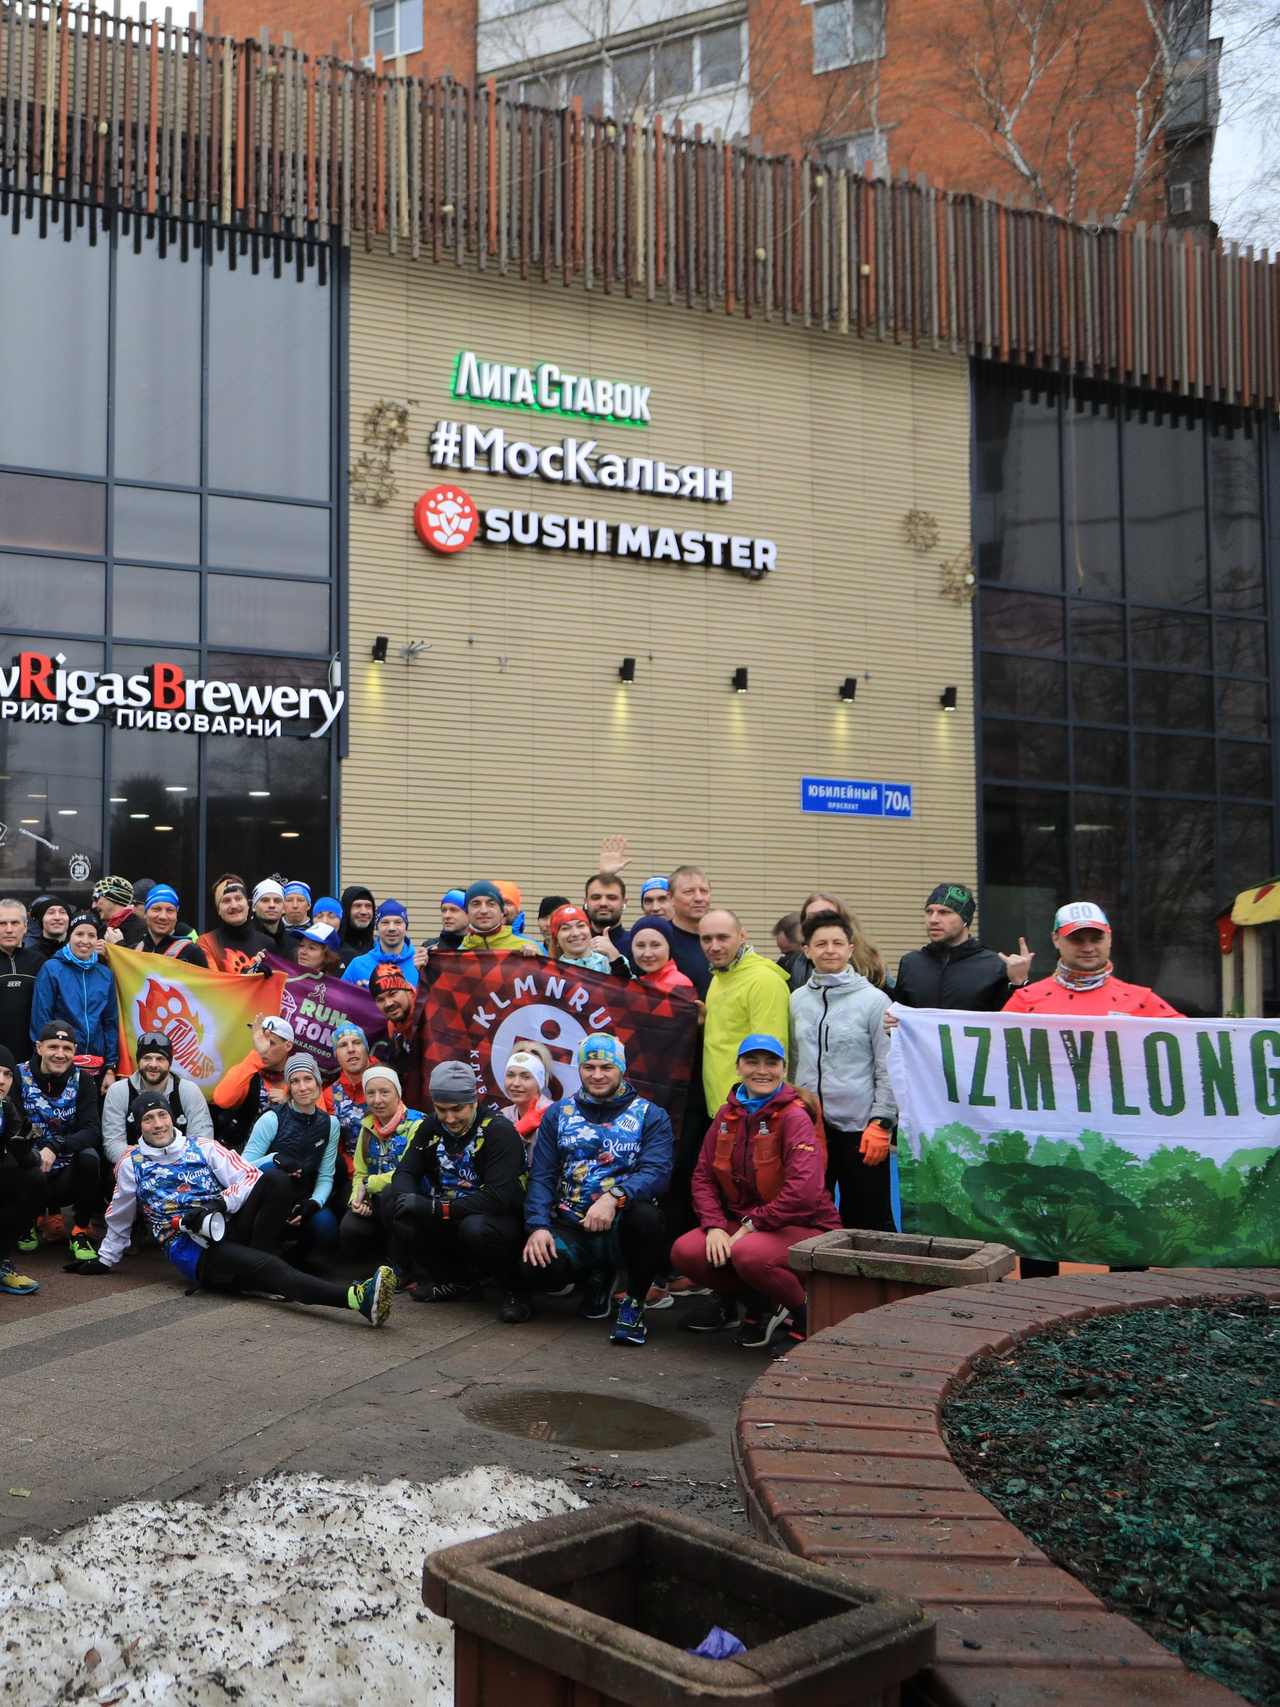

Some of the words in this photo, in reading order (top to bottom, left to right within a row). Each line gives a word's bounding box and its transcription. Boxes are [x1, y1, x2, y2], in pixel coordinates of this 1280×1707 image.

[431, 420, 734, 502] #МосКальян
[484, 508, 608, 553] SUSHI
[617, 523, 778, 571] MASTER
[116, 708, 282, 737] ПИВОВАРНИ
[808, 784, 878, 801] ЮБИЛЕЙНЫЙ
[827, 801, 859, 811] ПРОСПЕКТ
[300, 998, 348, 1028] RUN
[472, 975, 612, 1029] KLMNRU
[470, 1050, 488, 1095] КЛУБ
